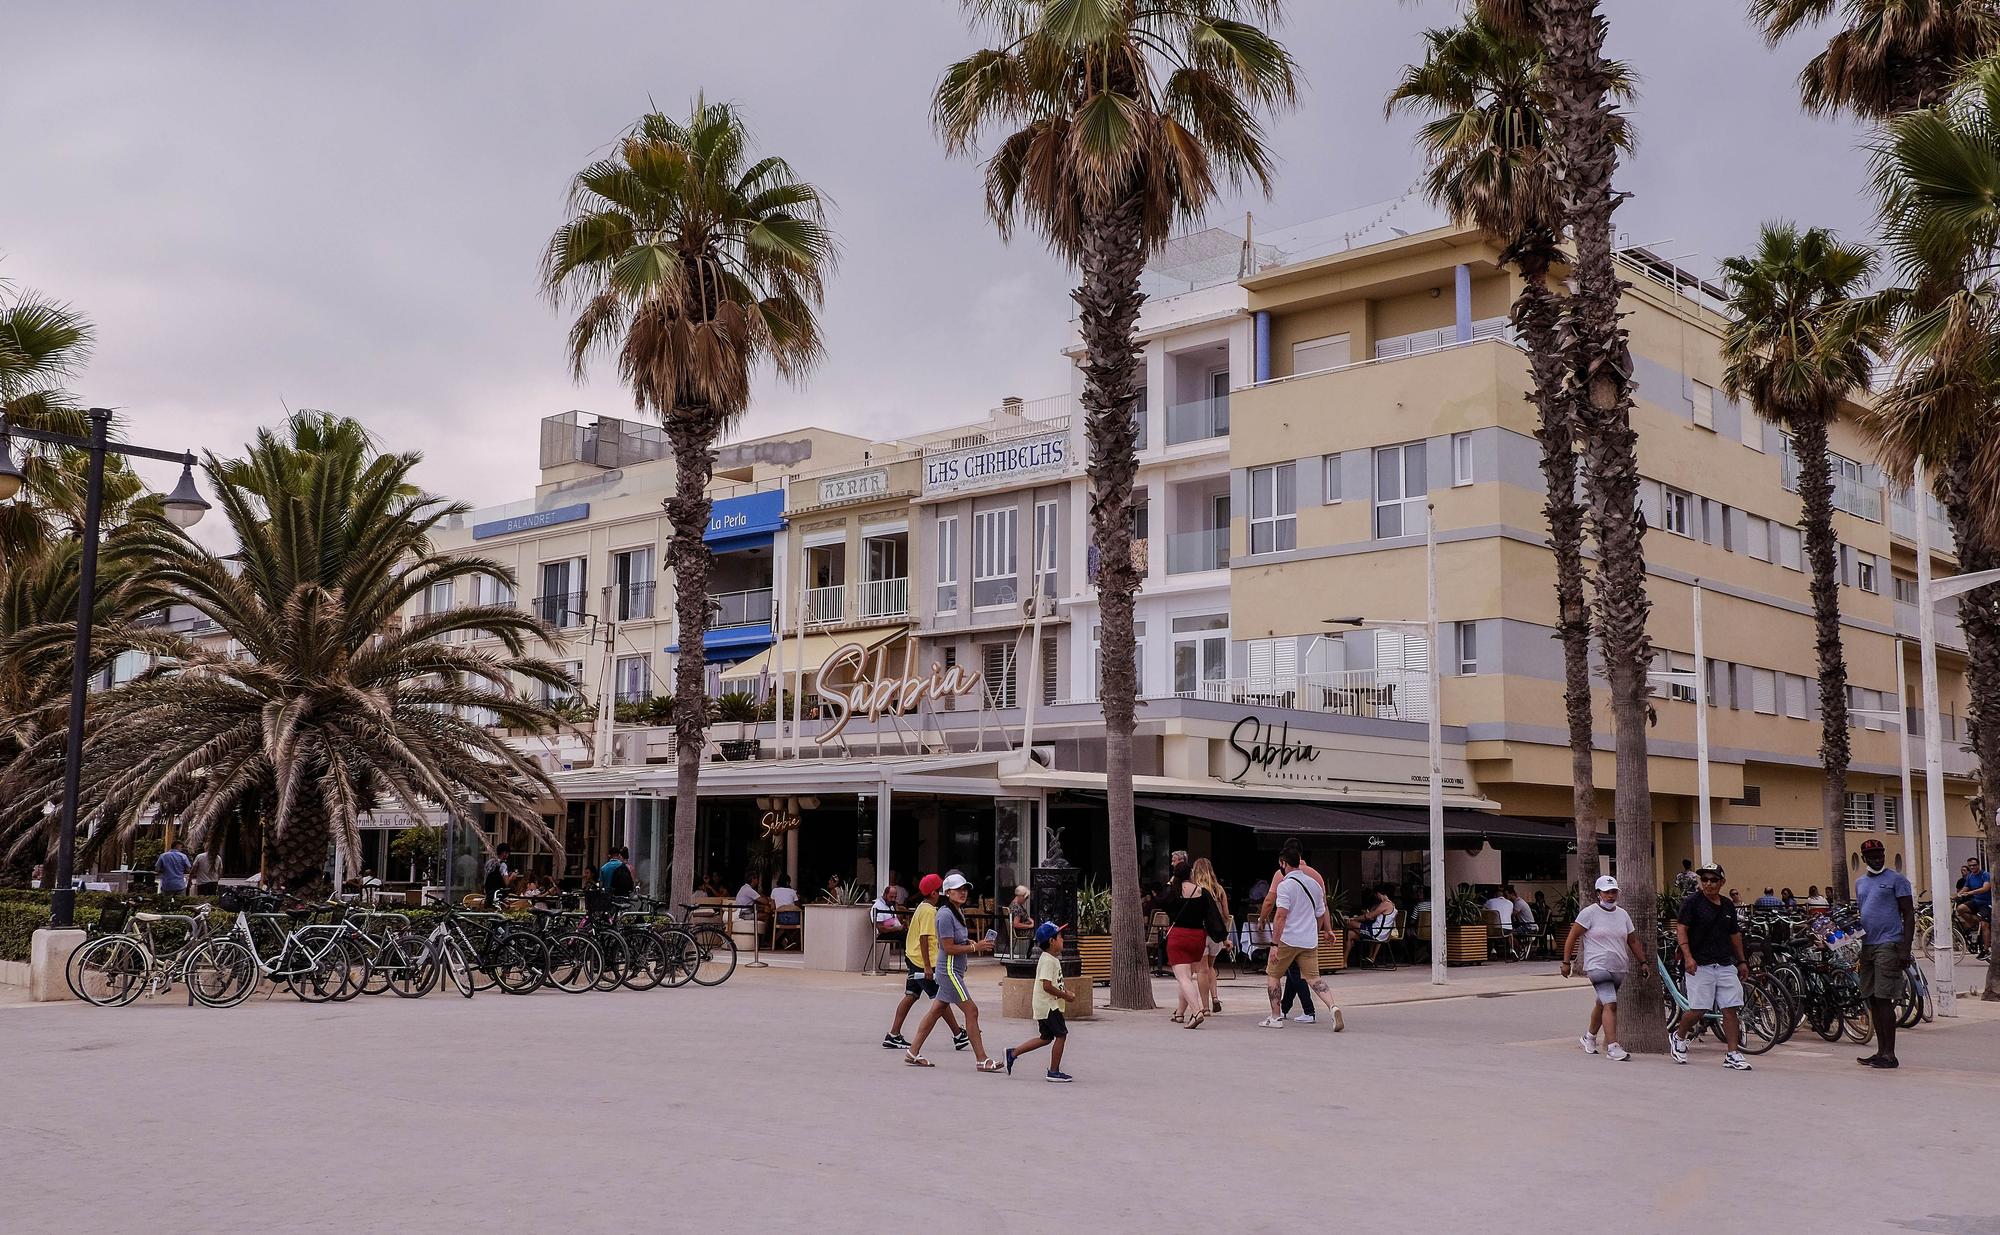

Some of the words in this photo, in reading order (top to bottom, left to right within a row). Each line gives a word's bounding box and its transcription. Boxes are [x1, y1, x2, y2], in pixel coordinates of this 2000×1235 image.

[928, 459, 959, 485] LAS
[964, 440, 1064, 478] CARABELAS
[507, 512, 555, 531] BALANDRET
[711, 517, 721, 531] La
[724, 512, 747, 528] Perla
[815, 637, 982, 744] Sabbia
[1230, 716, 1320, 781] Sabbia
[761, 811, 800, 838] Sabbia
